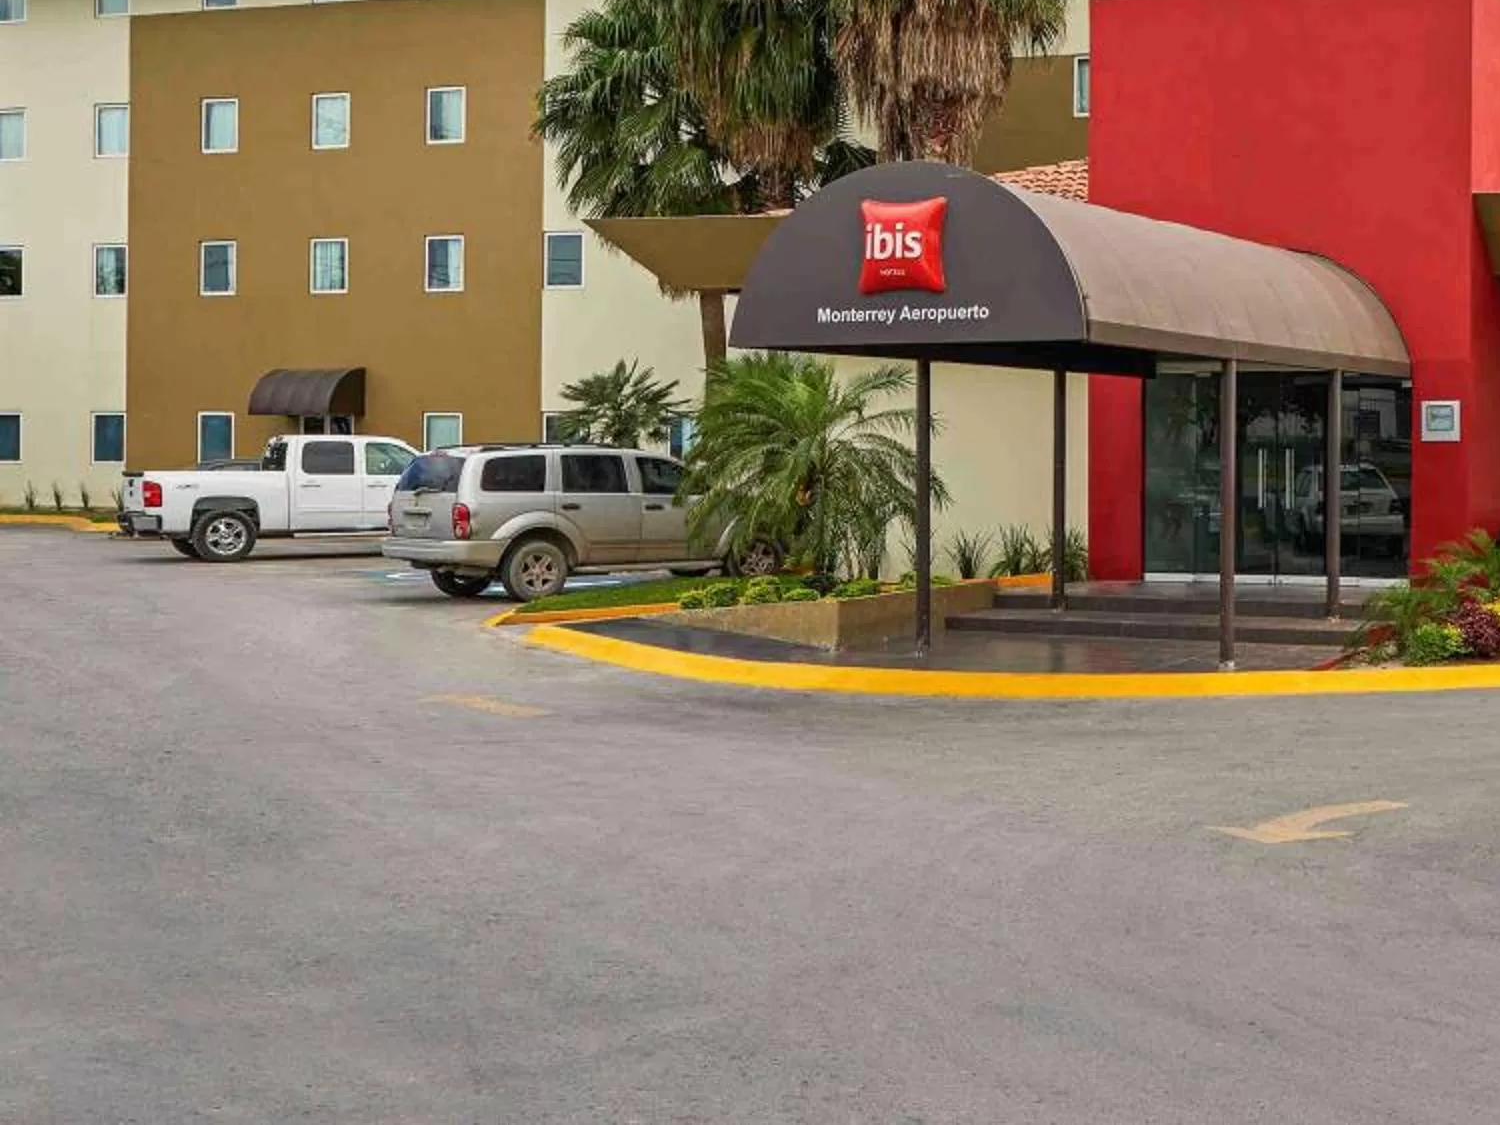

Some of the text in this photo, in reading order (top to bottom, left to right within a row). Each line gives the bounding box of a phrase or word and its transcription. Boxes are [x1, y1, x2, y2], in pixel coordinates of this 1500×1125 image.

[865, 222, 923, 260] ibis
[817, 305, 990, 324] Monterrey Aeropuerto
